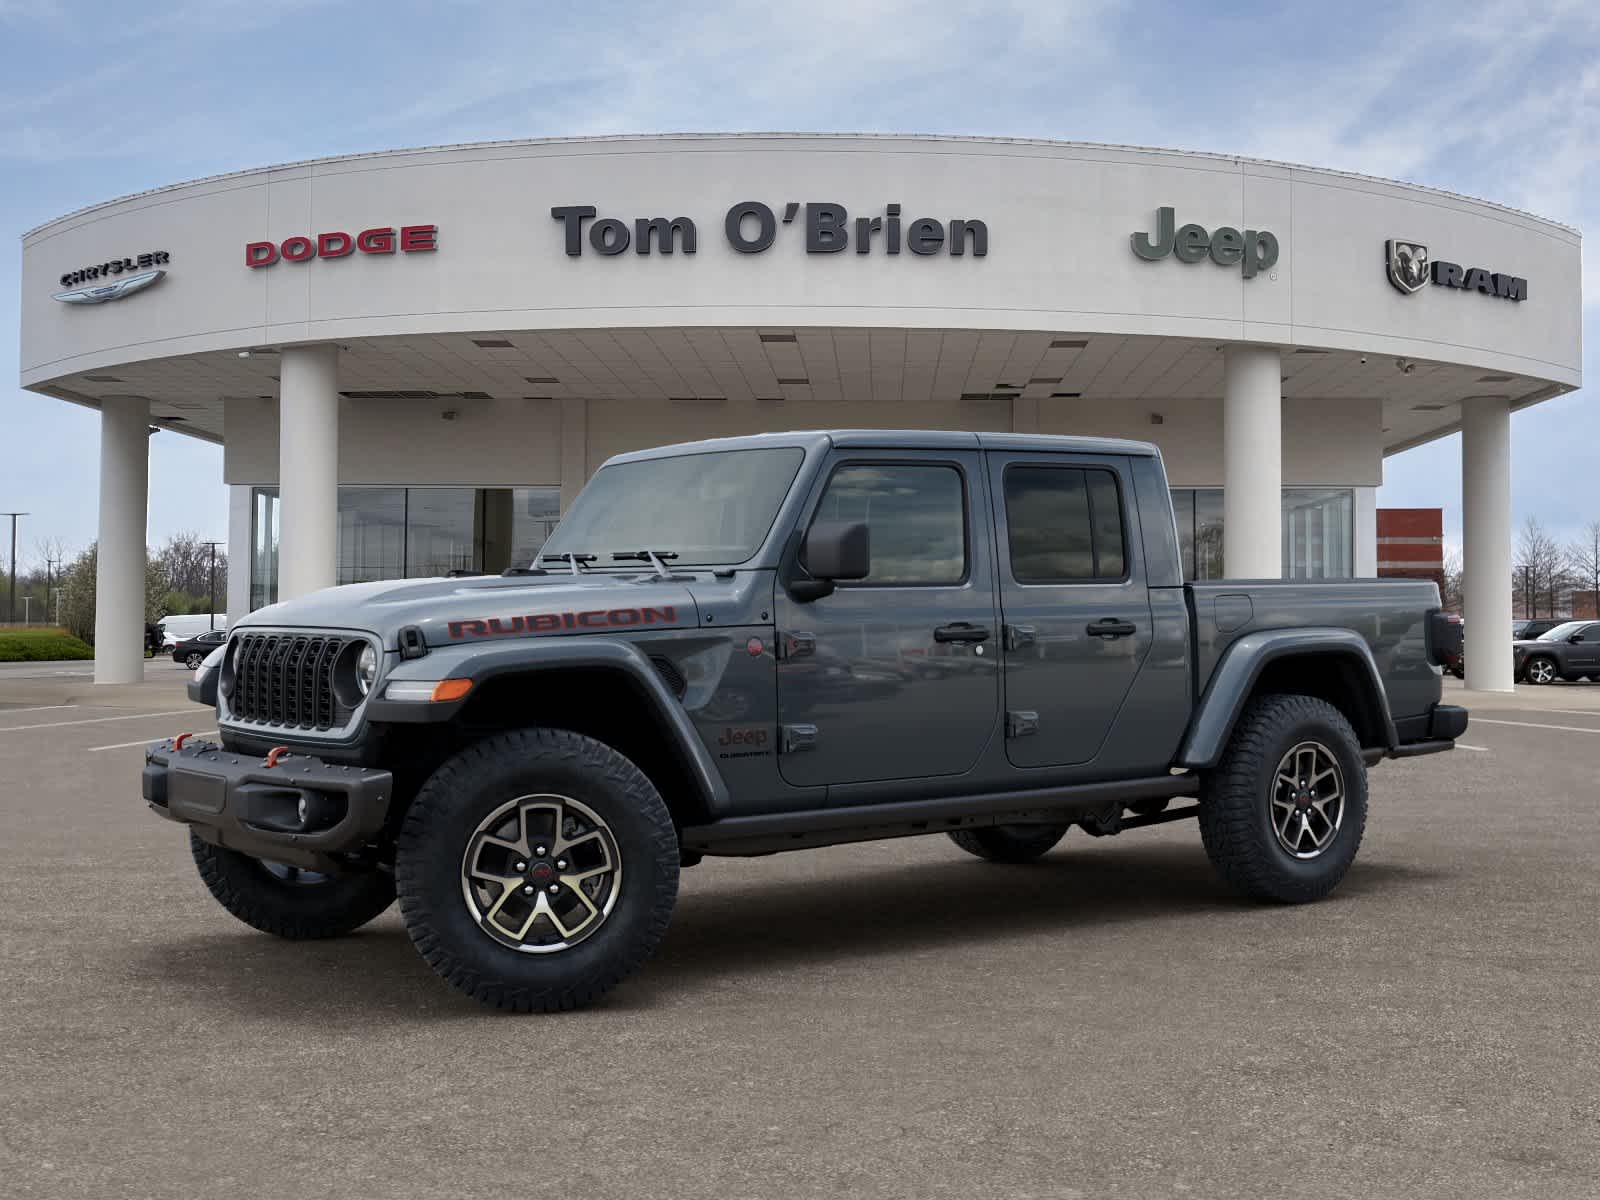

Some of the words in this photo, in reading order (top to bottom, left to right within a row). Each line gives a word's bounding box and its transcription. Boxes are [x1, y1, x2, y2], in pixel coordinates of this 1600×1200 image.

[245, 224, 438, 268] DODGE
[551, 205, 697, 257] Tom
[725, 201, 989, 257] O'Brien
[1130, 206, 1280, 279] Jeep
[60, 250, 170, 287] CHRYSLER
[1431, 260, 1528, 301] RAM
[448, 606, 677, 639] RUBICON
[719, 727, 768, 747] Jeep
